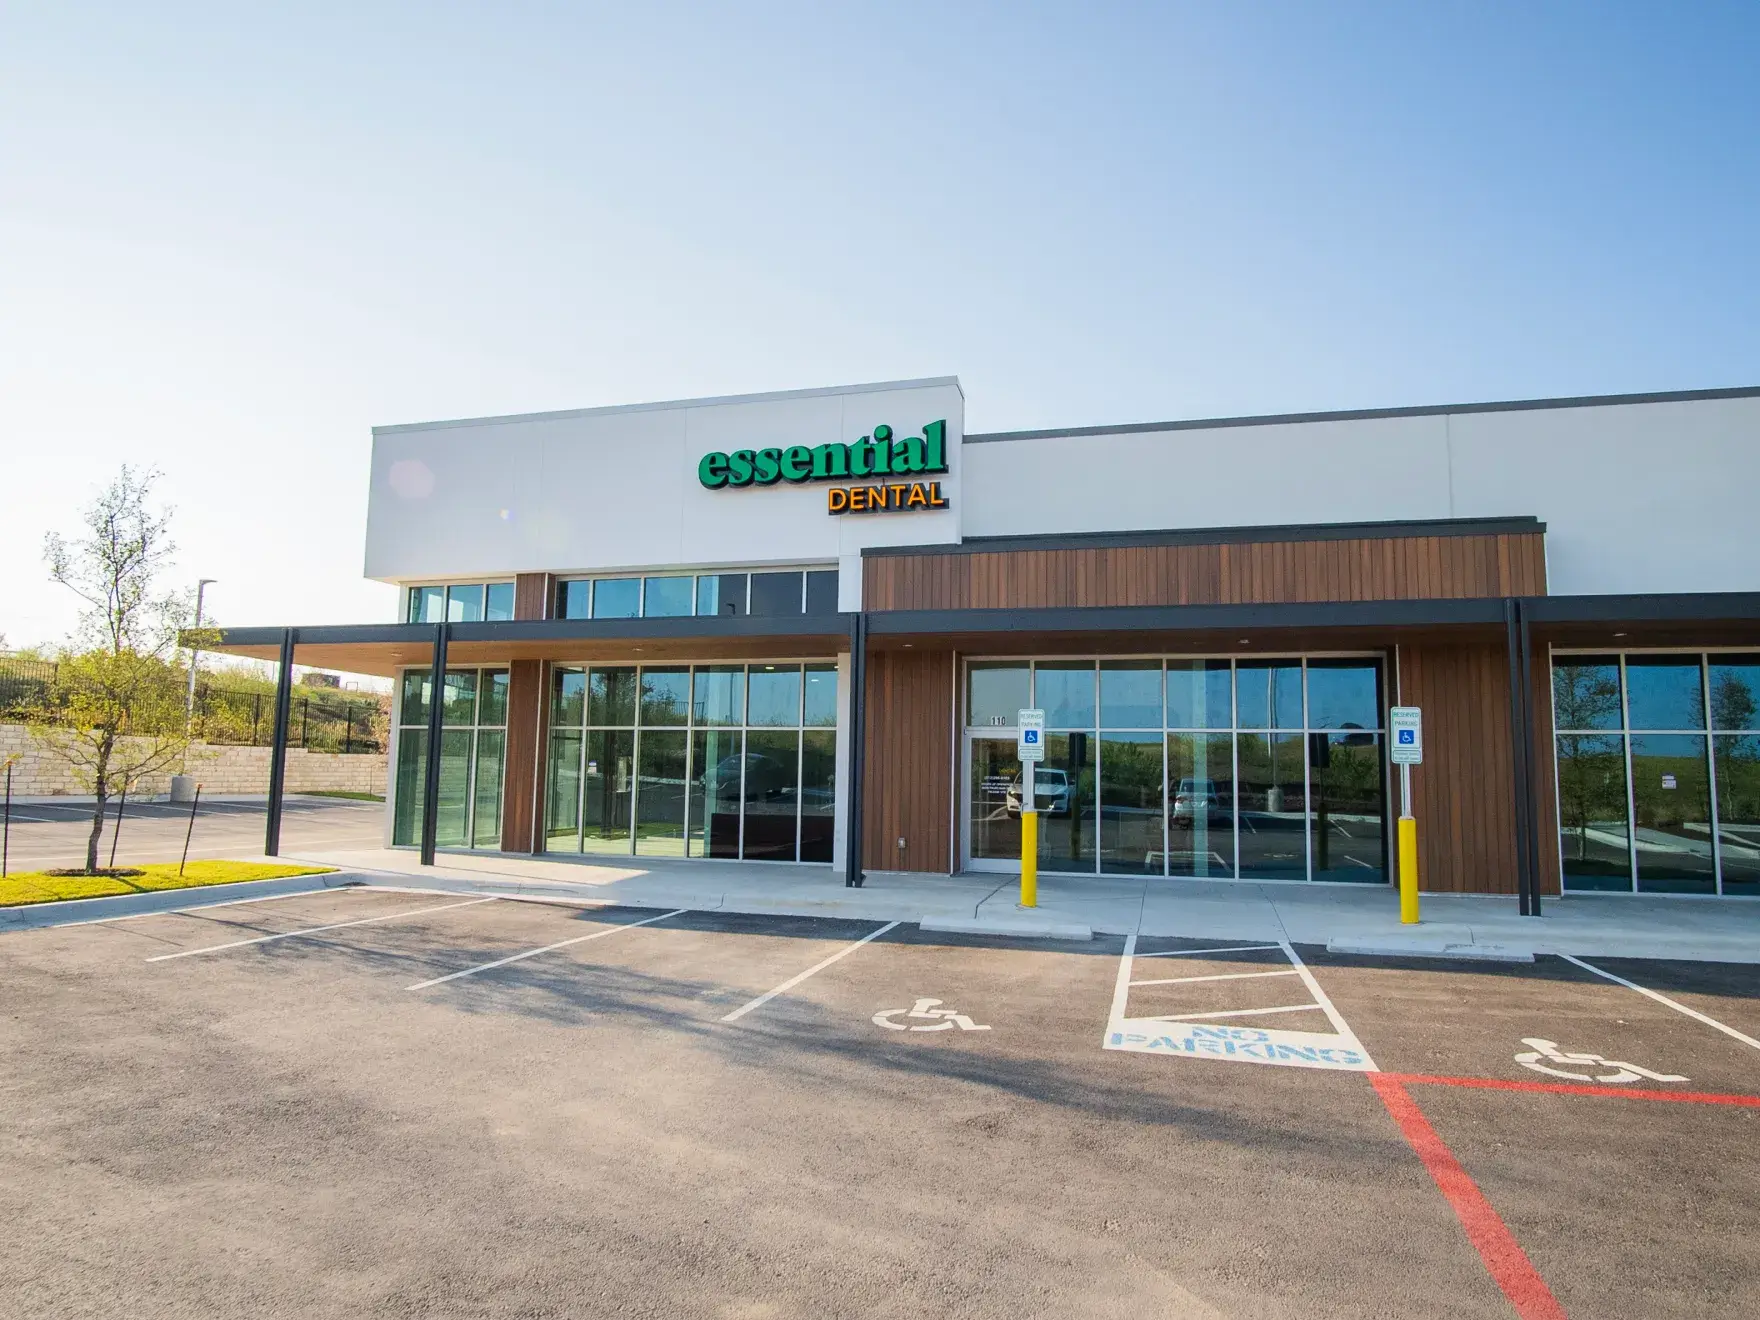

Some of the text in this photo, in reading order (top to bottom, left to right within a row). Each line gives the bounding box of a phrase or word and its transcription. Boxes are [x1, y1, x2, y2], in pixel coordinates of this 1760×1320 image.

[698, 419, 948, 490] essential
[829, 482, 949, 515] DENTAL
[991, 716, 1006, 726] 110
[1110, 1032, 1363, 1064] PARKING
[1192, 1026, 1269, 1042] NO
